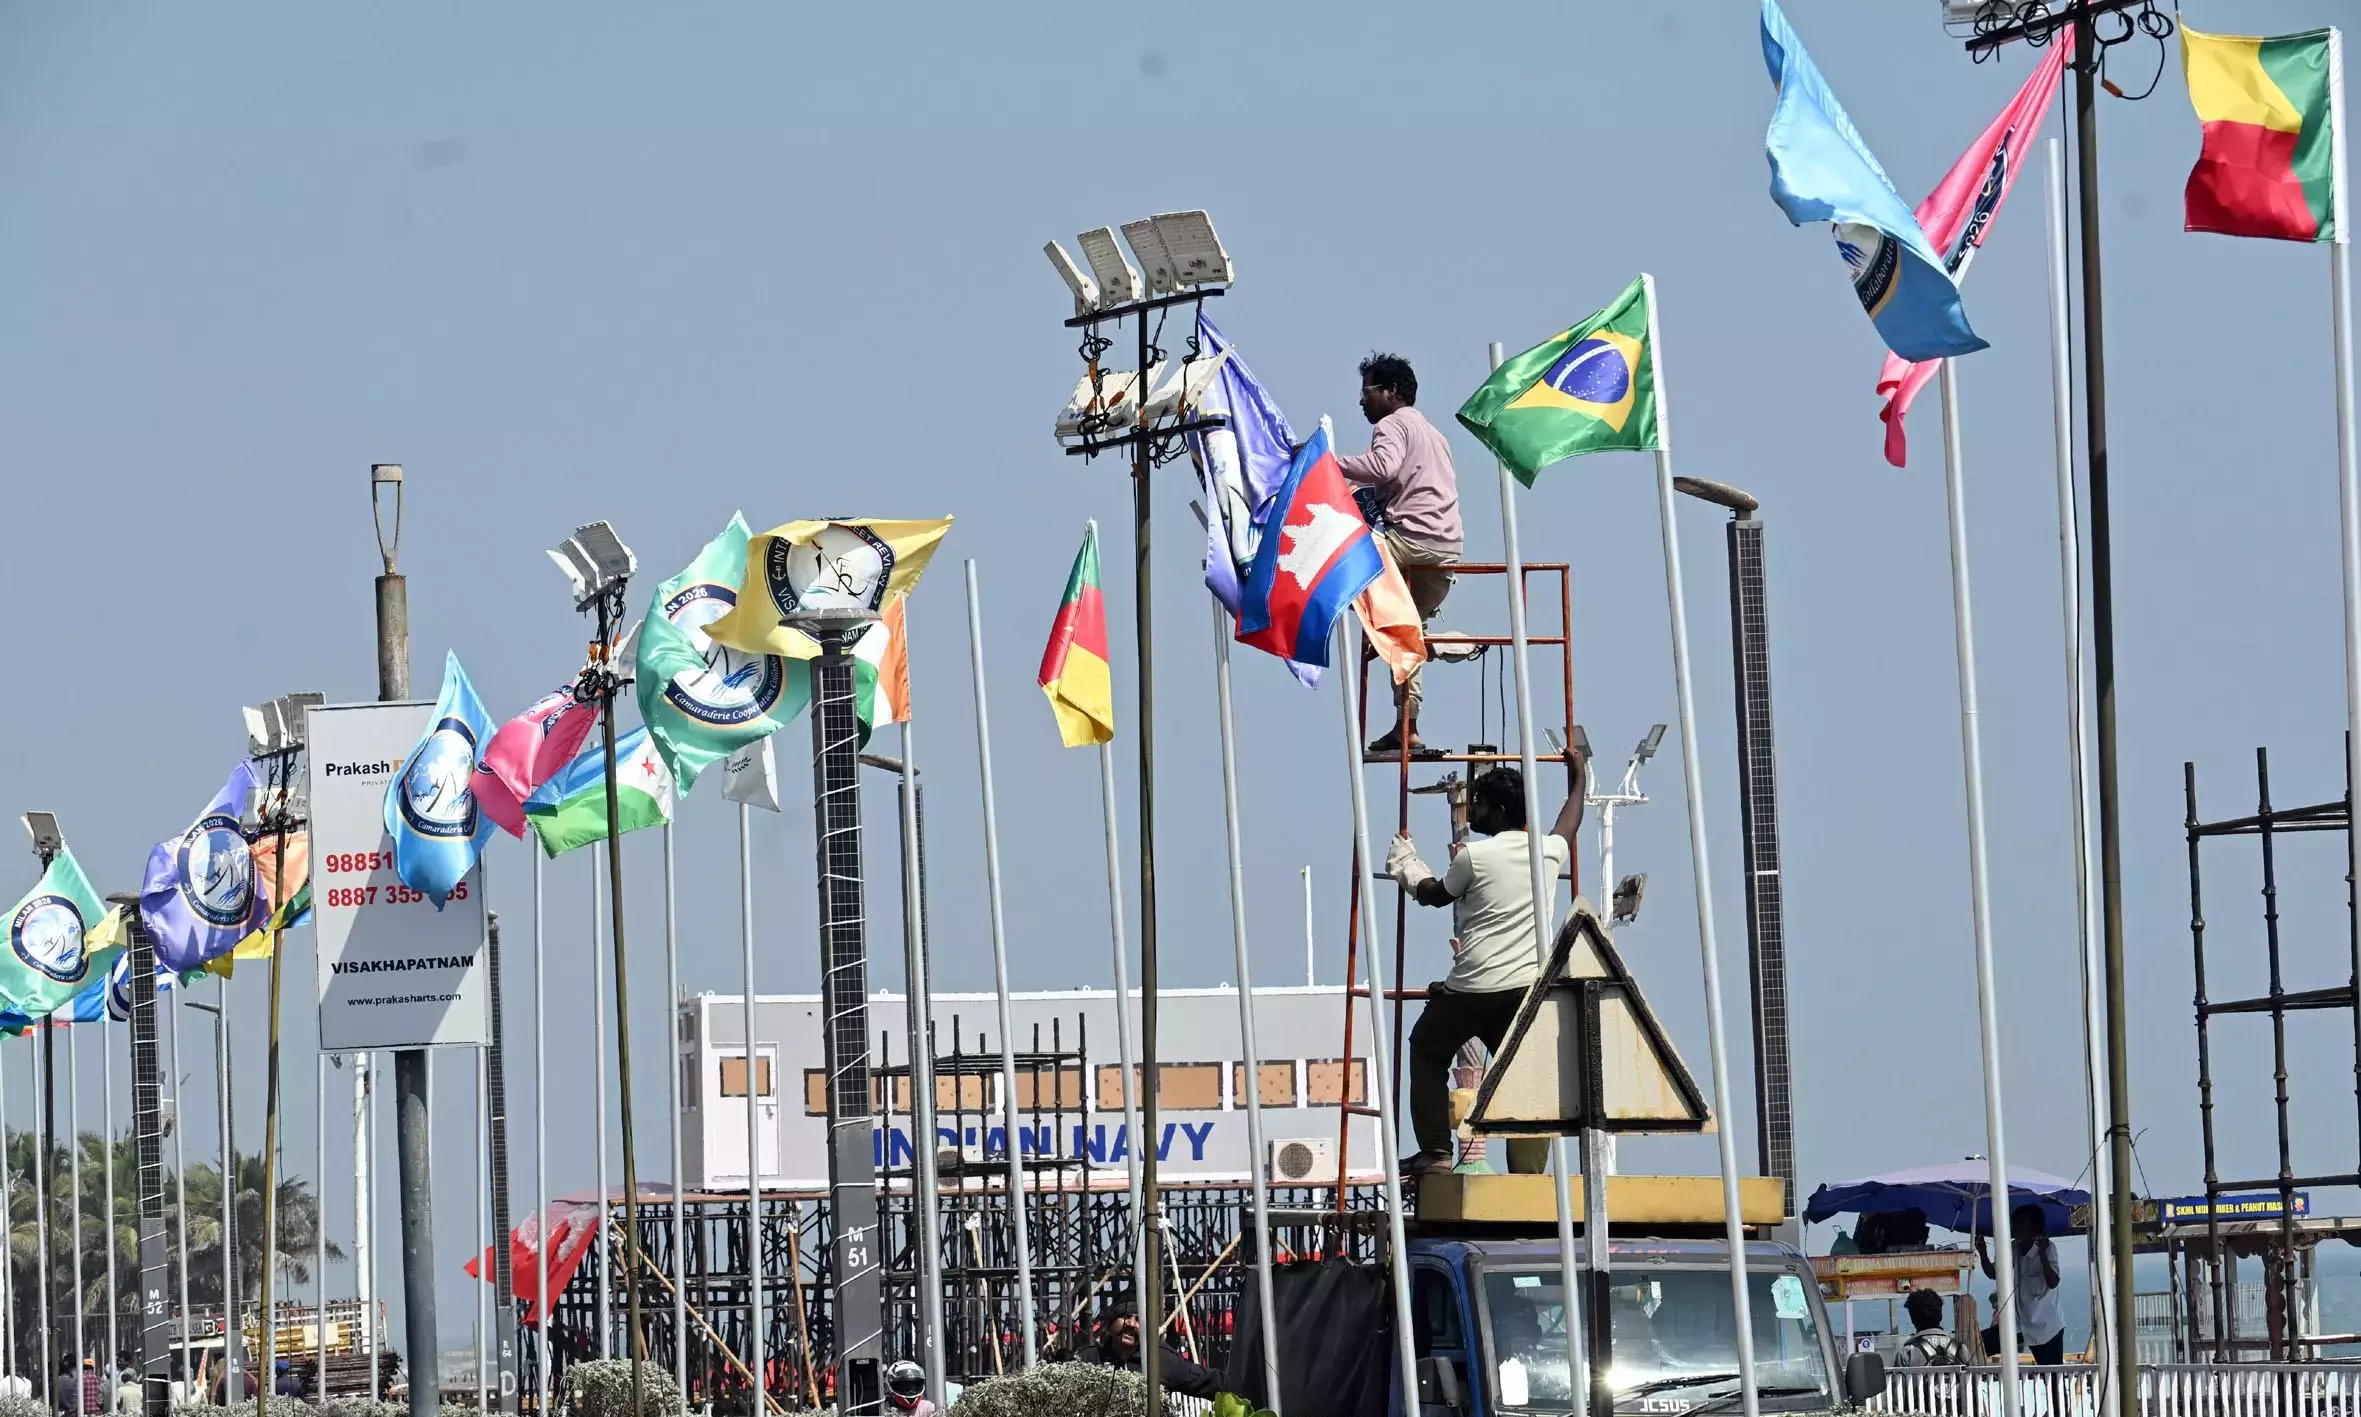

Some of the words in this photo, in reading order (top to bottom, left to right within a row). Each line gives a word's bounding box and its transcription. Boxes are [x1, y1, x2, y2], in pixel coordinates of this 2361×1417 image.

[678, 587, 708, 604] 2026
[674, 692, 731, 721] Camaraderie
[325, 760, 391, 776] Prakash
[418, 820, 464, 834] Camaraderie
[325, 851, 393, 873] 98851
[327, 886, 378, 907] 8887
[331, 955, 474, 975] VISAKHAPATNAM
[347, 993, 462, 1006] www.prakasharts.com
[2241, 1202, 2266, 1213] PEANUT
[848, 1226, 863, 1242] M
[848, 1247, 867, 1267] 51
[149, 1289, 160, 1300] M
[147, 1302, 163, 1315] 52
